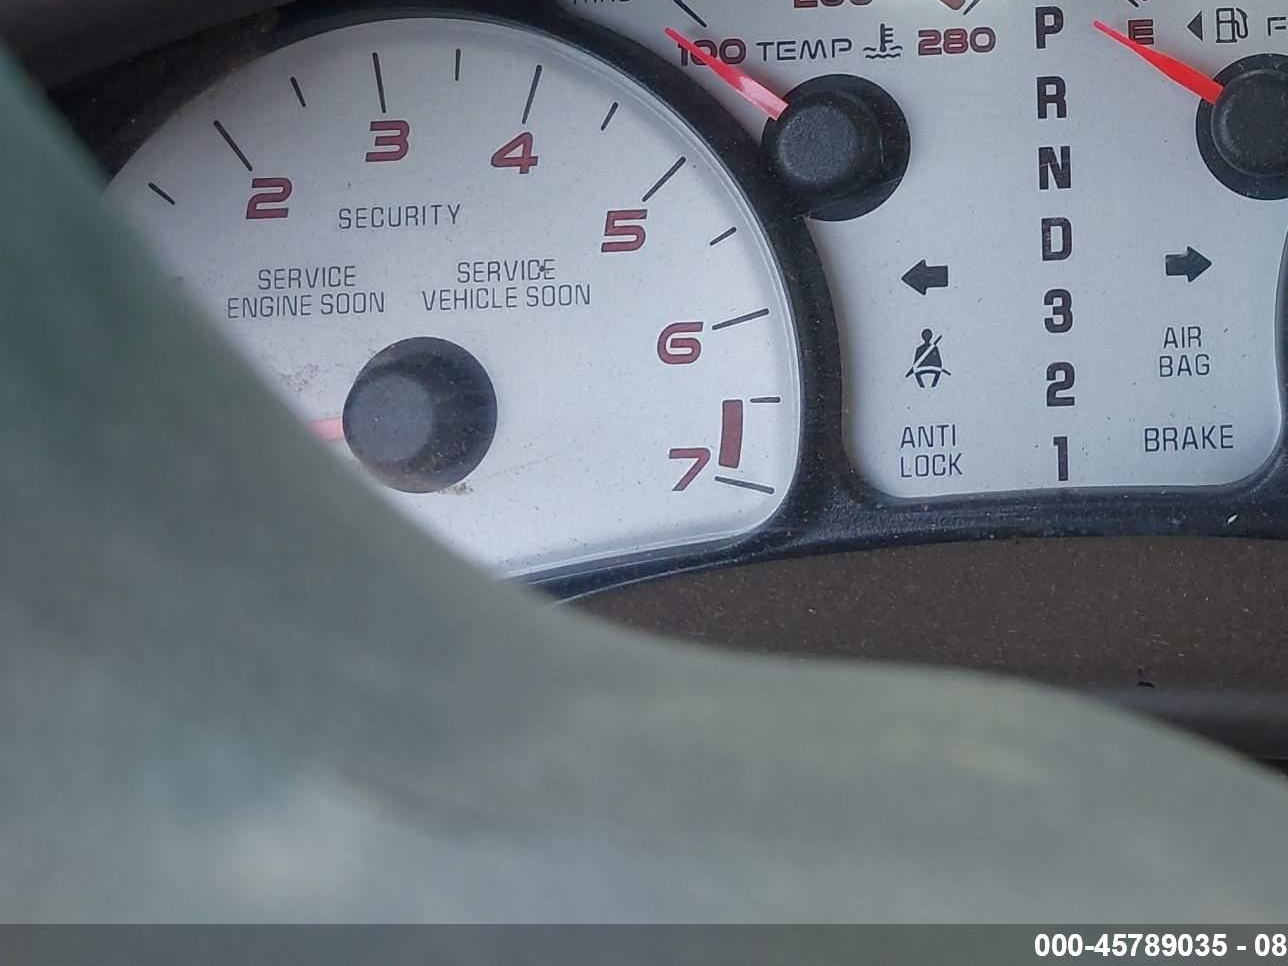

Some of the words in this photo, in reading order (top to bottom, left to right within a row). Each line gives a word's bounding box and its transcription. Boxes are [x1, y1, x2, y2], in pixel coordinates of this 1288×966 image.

[916, 26, 998, 56] 280
[1035, 7, 1063, 48] P
[1126, 17, 1156, 46] E
[676, 37, 748, 68] 100
[755, 38, 854, 62] TEMP
[1037, 76, 1067, 118] R
[366, 119, 409, 162] 3
[491, 131, 538, 174] 4
[1038, 146, 1071, 189] N
[246, 178, 292, 219] 2
[336, 201, 463, 230] SECURITY
[601, 210, 647, 253] 5
[1041, 217, 1072, 261] D
[256, 263, 359, 292] SERVICE
[454, 256, 557, 284] SERVICE
[225, 293, 314, 321] ENGINE
[318, 291, 386, 317] SOON
[421, 285, 520, 312] VEHICLE
[523, 282, 592, 309] SOON
[1044, 289, 1073, 334] 3
[657, 321, 703, 364] 6
[1160, 325, 1204, 350] AIR
[1046, 362, 1075, 406] 2
[1157, 353, 1213, 379] BAG
[898, 423, 959, 450] ANTI
[1143, 423, 1236, 453] BRAKE
[669, 448, 710, 490] 7
[898, 452, 965, 479] LOCK
[1052, 436, 1068, 480] 1
